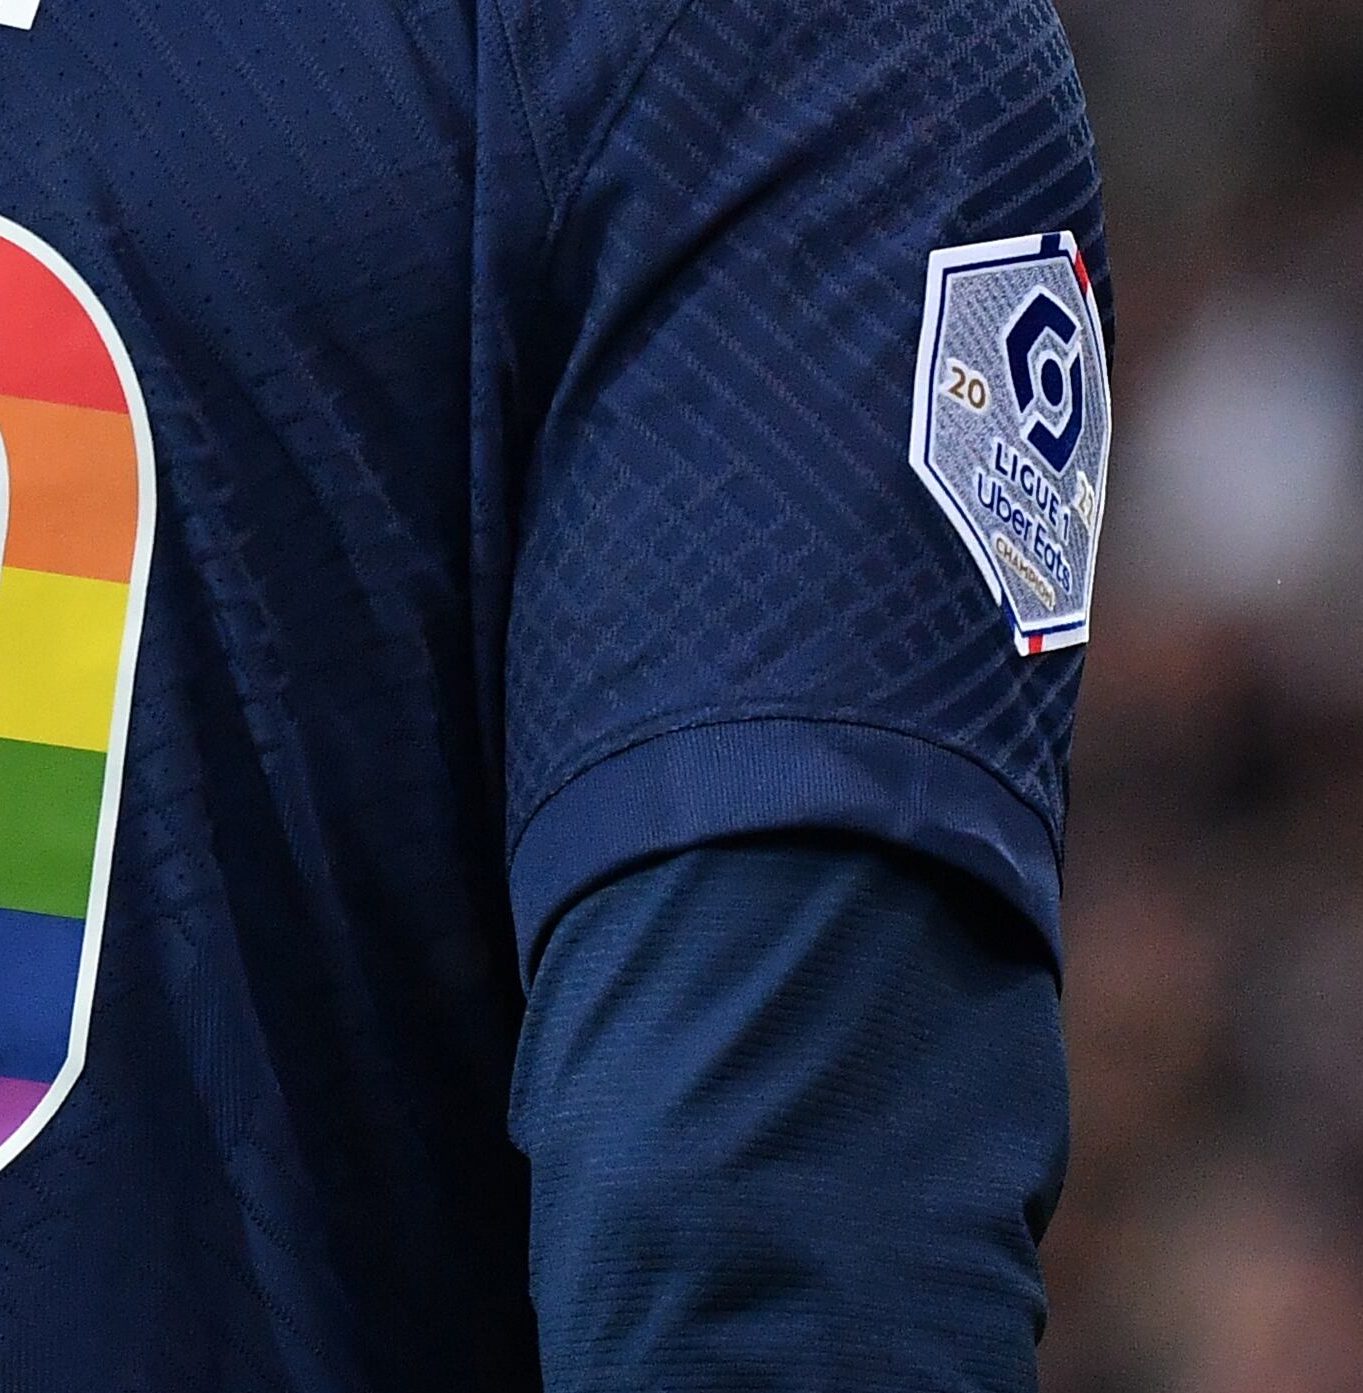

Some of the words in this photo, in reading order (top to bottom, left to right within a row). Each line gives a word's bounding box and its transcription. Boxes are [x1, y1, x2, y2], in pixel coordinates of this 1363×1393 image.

[948, 367, 986, 409] 20
[995, 442, 1059, 526] LIGUE
[978, 472, 1033, 541] Uber
[1034, 524, 1071, 593] Eats
[996, 537, 1054, 607] CHAMPION
